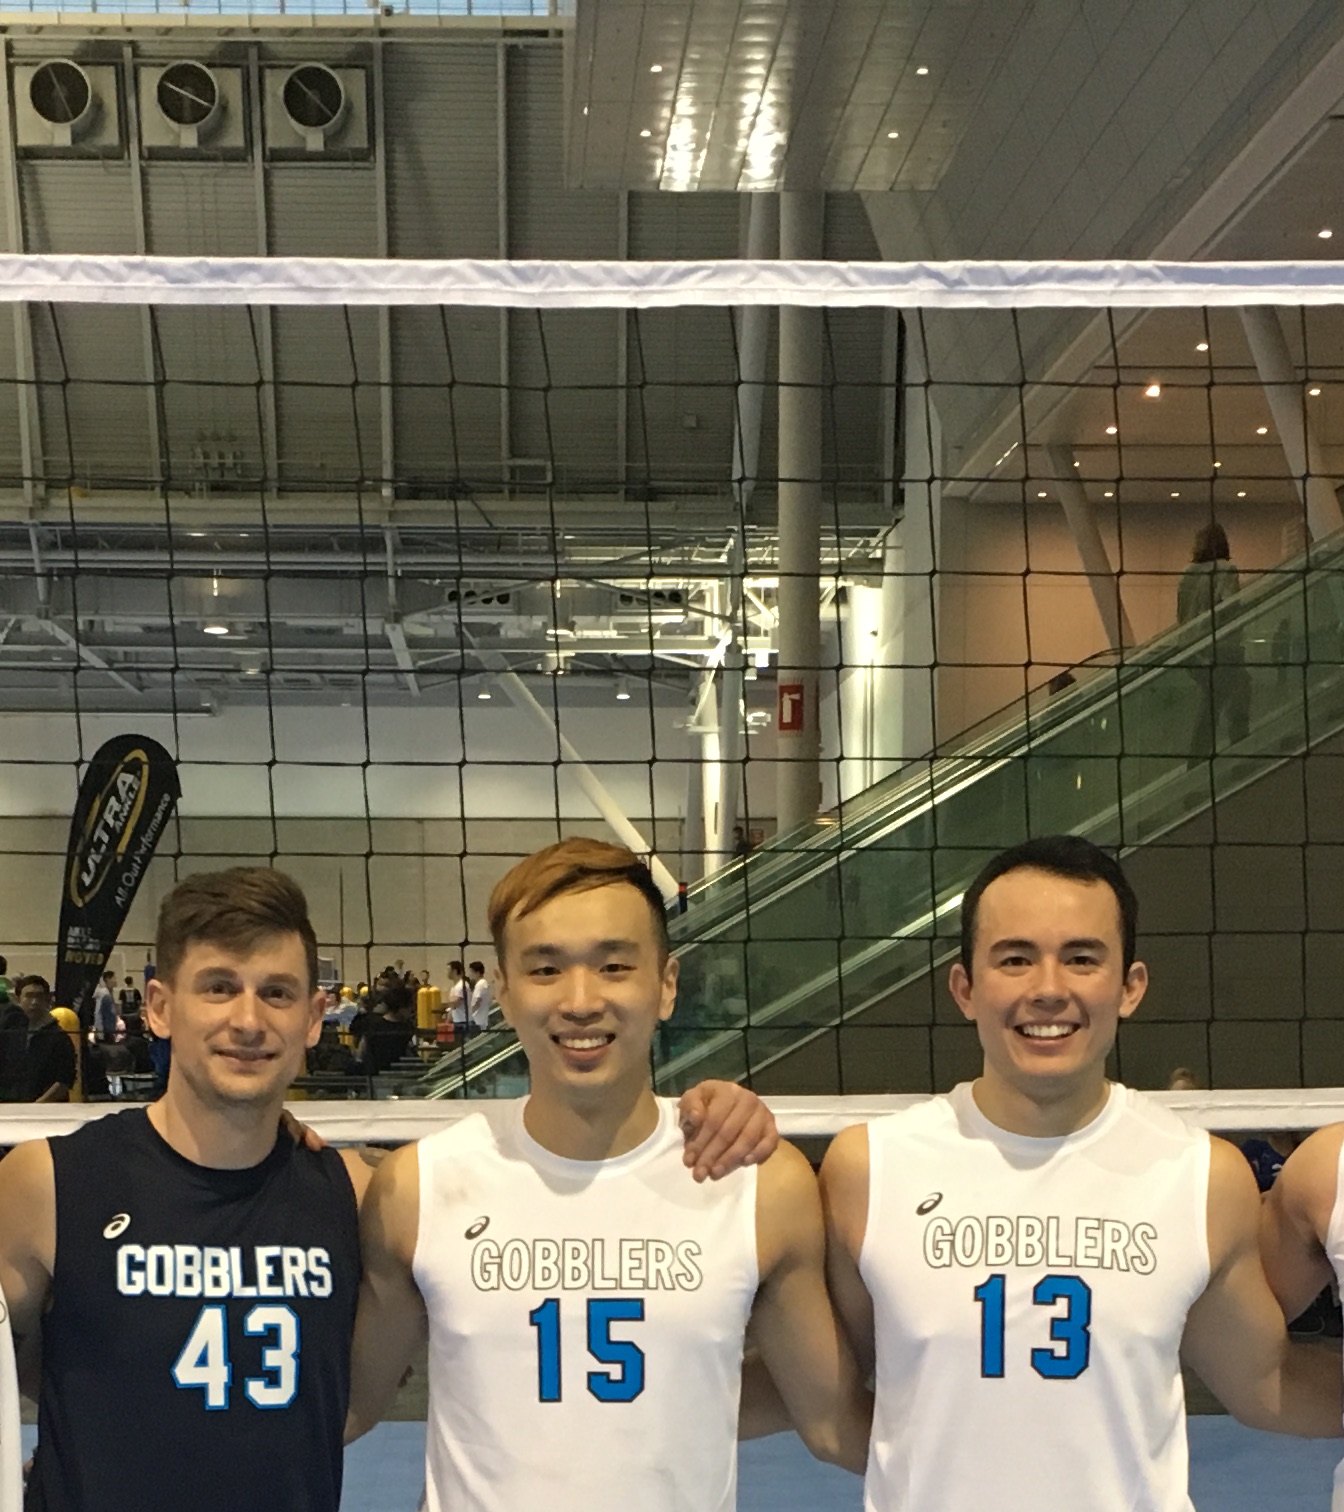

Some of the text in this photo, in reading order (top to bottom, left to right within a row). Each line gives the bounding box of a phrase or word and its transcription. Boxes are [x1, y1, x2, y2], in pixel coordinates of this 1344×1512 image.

[81, 772, 136, 887] ULTRA
[115, 774, 142, 834] ANKLE
[115, 1243, 334, 1299] GOBBLERS
[470, 1238, 704, 1292] GOBBLERS
[922, 1214, 1159, 1276] GOBBLERS
[170, 1303, 301, 1411] 43
[529, 1297, 646, 1403] 15
[973, 1273, 1093, 1380] 13
